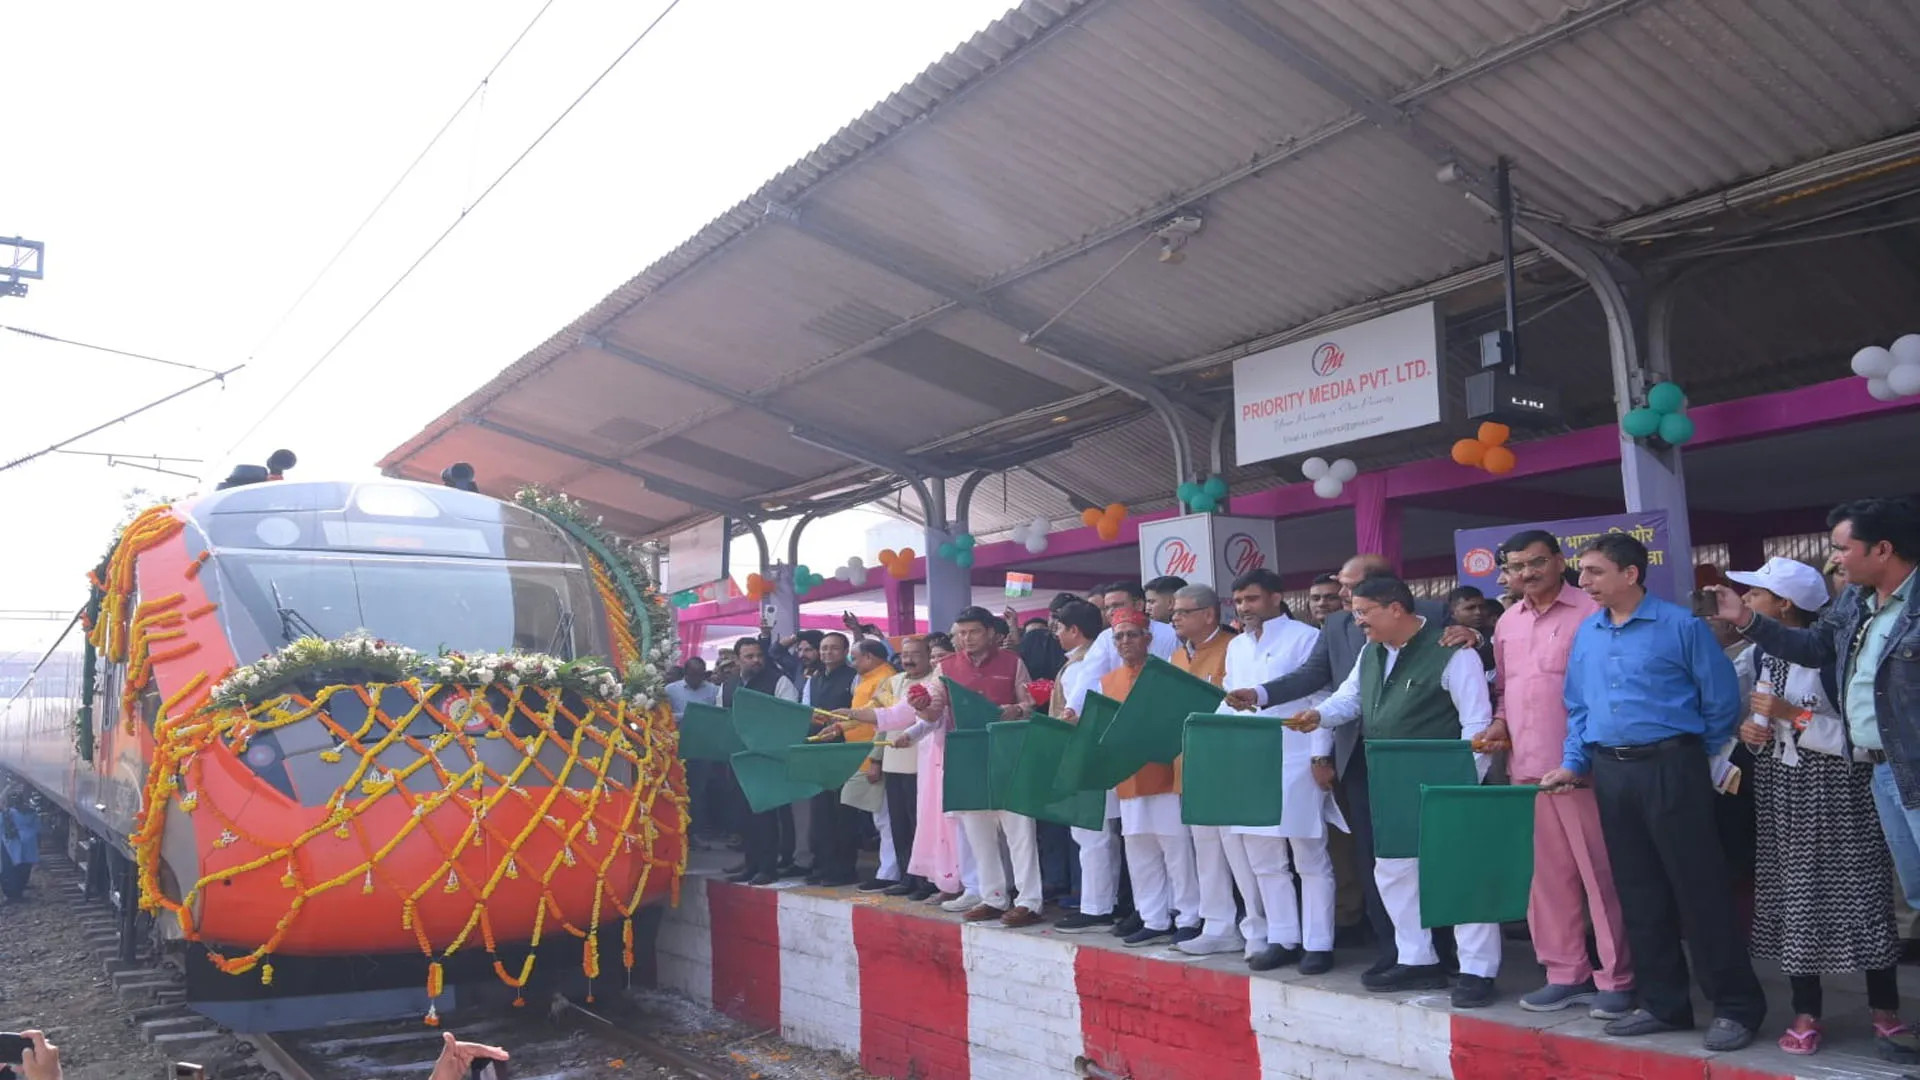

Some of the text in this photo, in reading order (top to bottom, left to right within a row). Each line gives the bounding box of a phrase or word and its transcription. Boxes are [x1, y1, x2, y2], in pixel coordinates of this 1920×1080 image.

[1242, 359, 1432, 422] PRIORITY MEDIA PVT. LTD.
